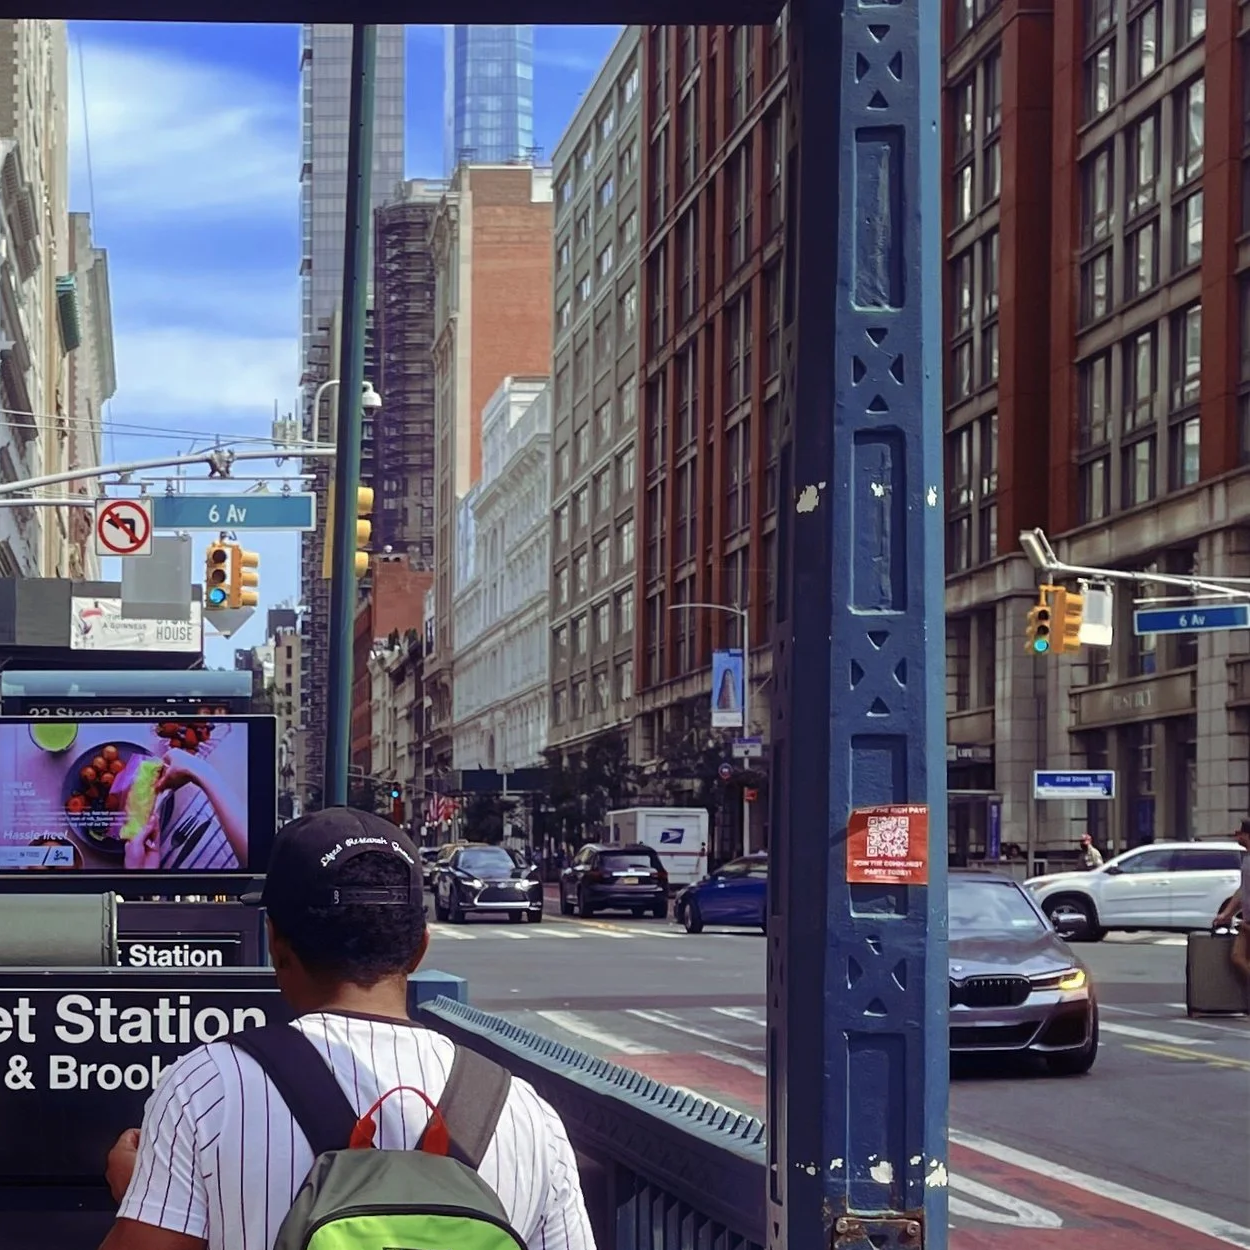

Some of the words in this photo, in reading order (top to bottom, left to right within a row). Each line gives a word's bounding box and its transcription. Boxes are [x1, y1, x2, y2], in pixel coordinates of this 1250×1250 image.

[208, 505, 218, 523] 6
[226, 504, 247, 523] Av
[1179, 614, 1187, 627] 6
[1191, 613, 1206, 626] Av
[156, 626, 193, 641] HOUSE
[3, 830, 40, 840] Hassle
[128, 943, 223, 967] Station
[54, 993, 267, 1044] Station
[4, 1055, 36, 1090] &
[49, 1055, 183, 1091] Brook
